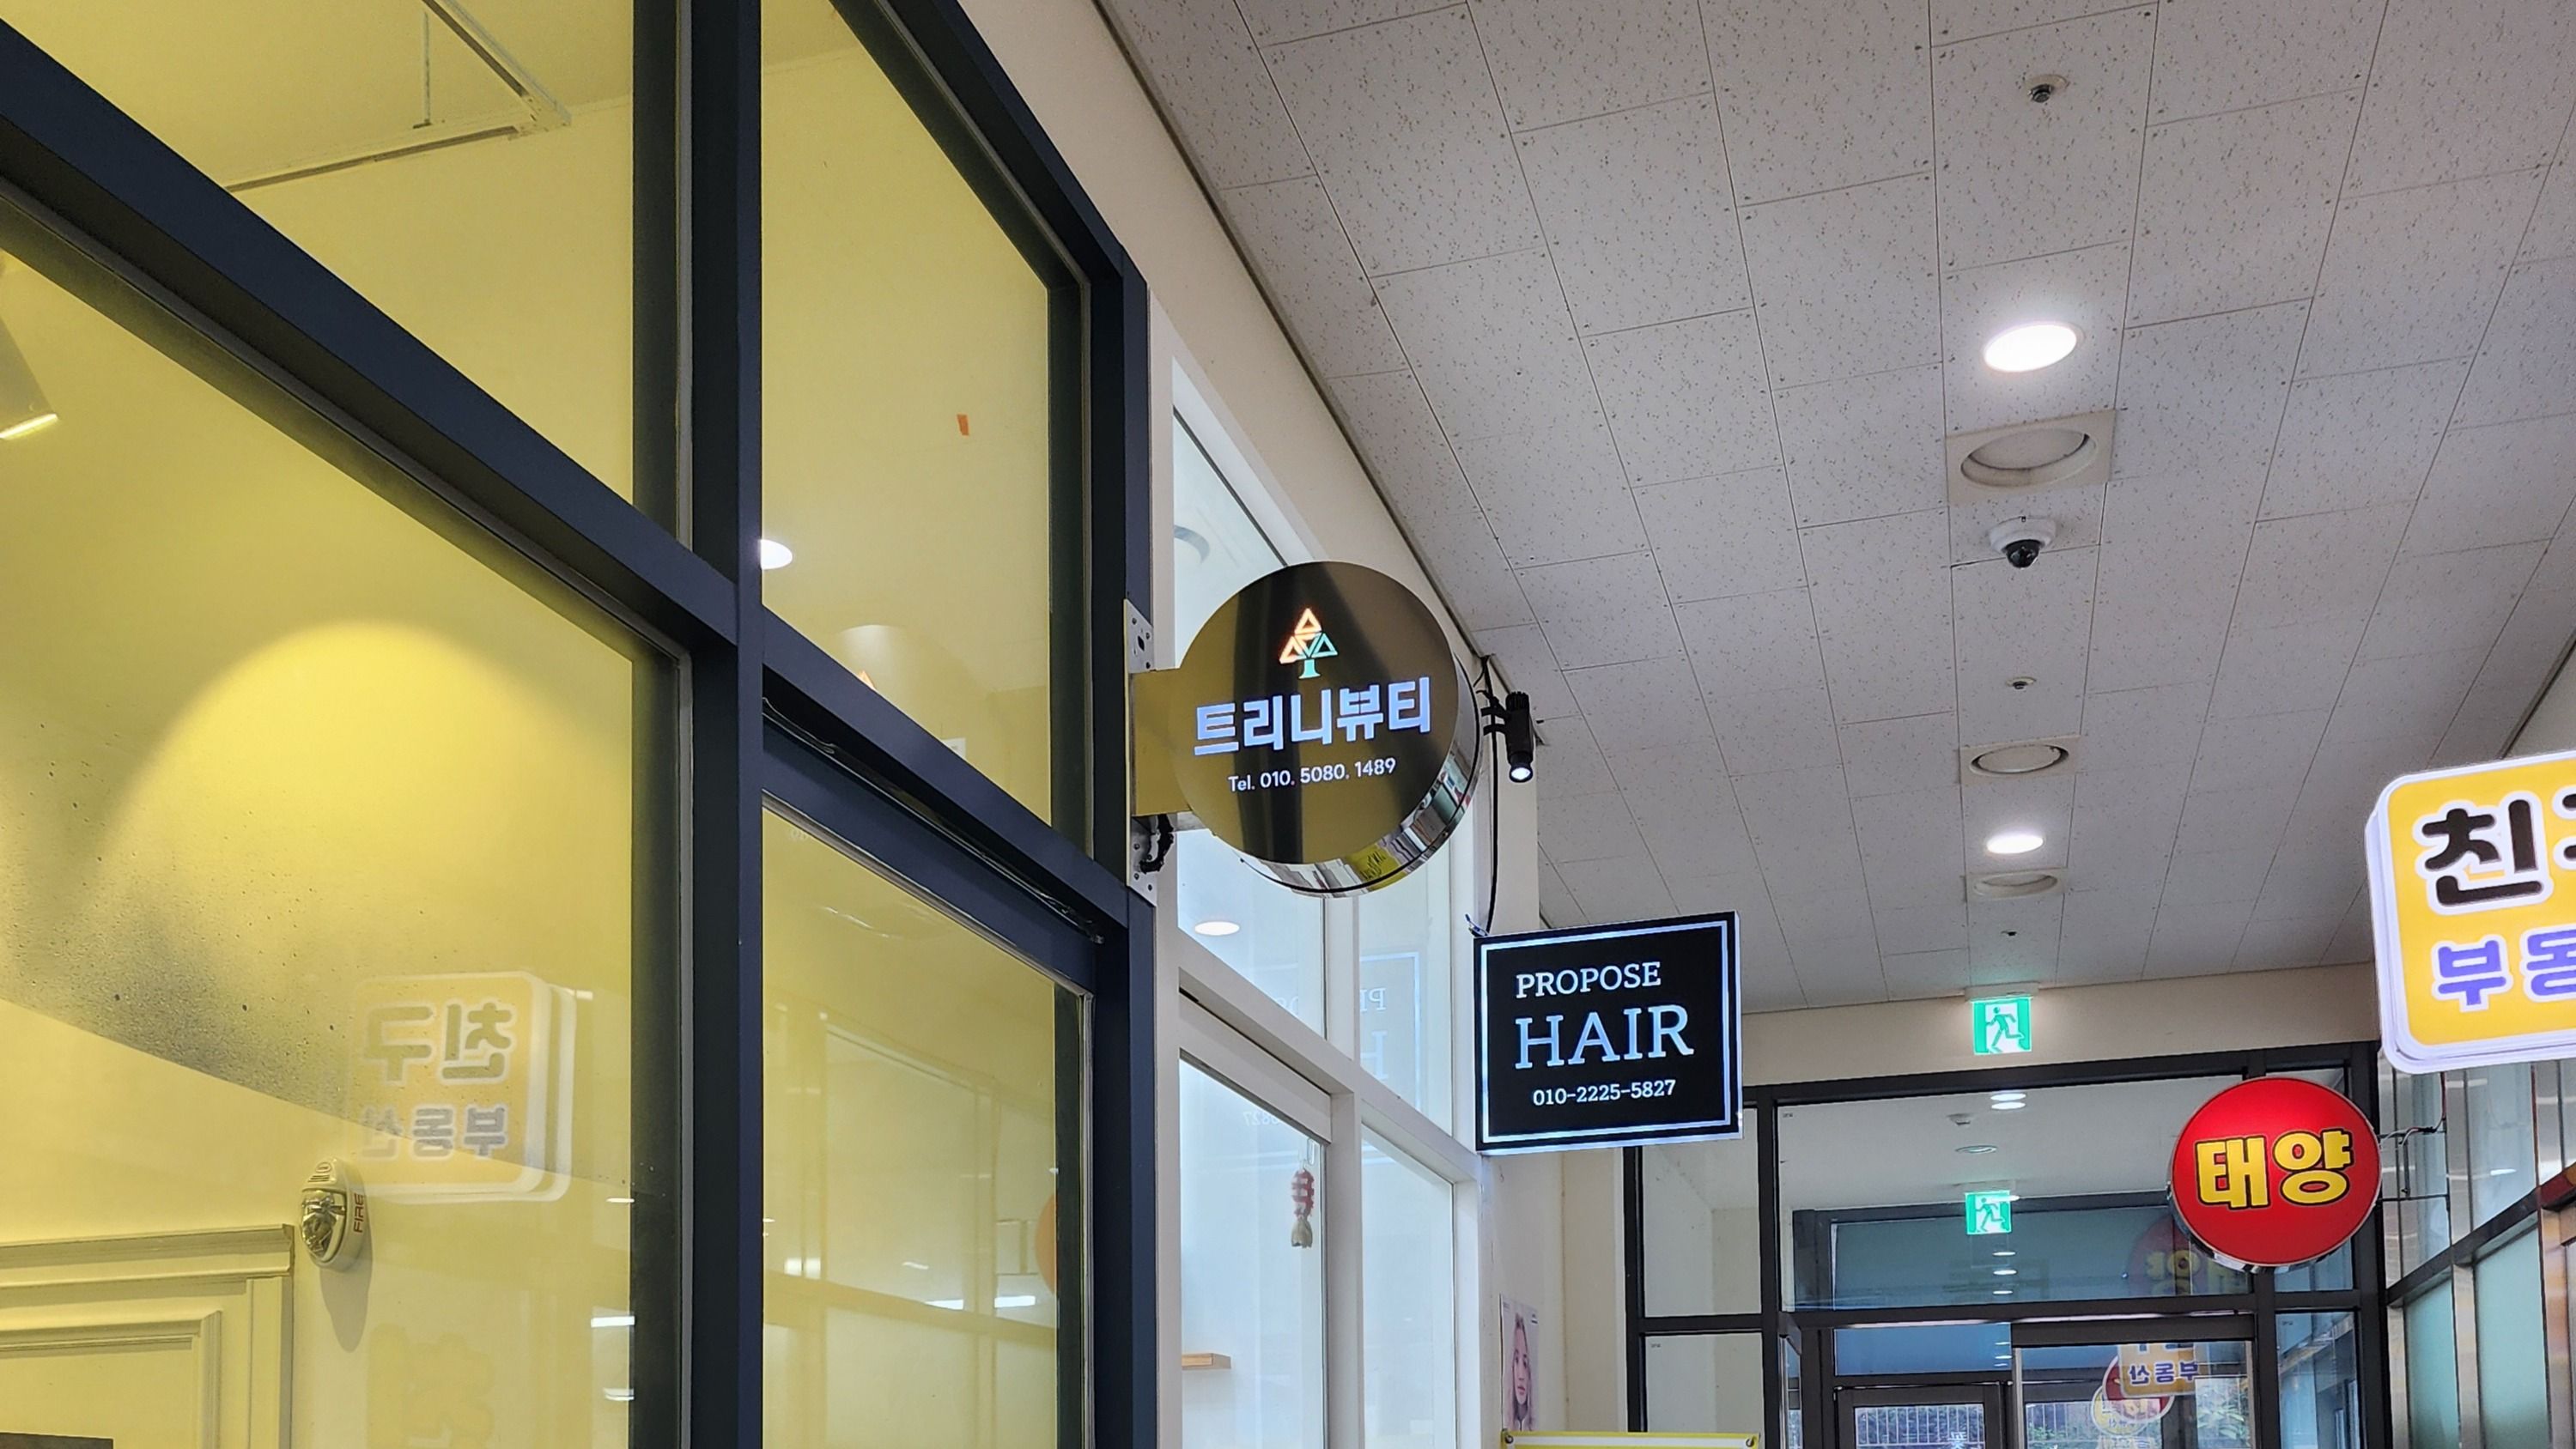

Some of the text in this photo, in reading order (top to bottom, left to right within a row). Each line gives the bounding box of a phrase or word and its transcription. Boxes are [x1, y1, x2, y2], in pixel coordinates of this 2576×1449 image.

[1194, 676, 1431, 755] 트리니뷰티
[1228, 756, 1397, 792] Tel. 010. 5080. 1489
[2421, 792, 2576, 906] 친
[1516, 961, 1662, 998] PROPOSE
[1515, 1003, 1695, 1070] HAIR
[1533, 1078, 1676, 1106] 010-2225-5827
[2195, 1128, 2353, 1210] 태양
[353, 1192, 365, 1234] FIRE
